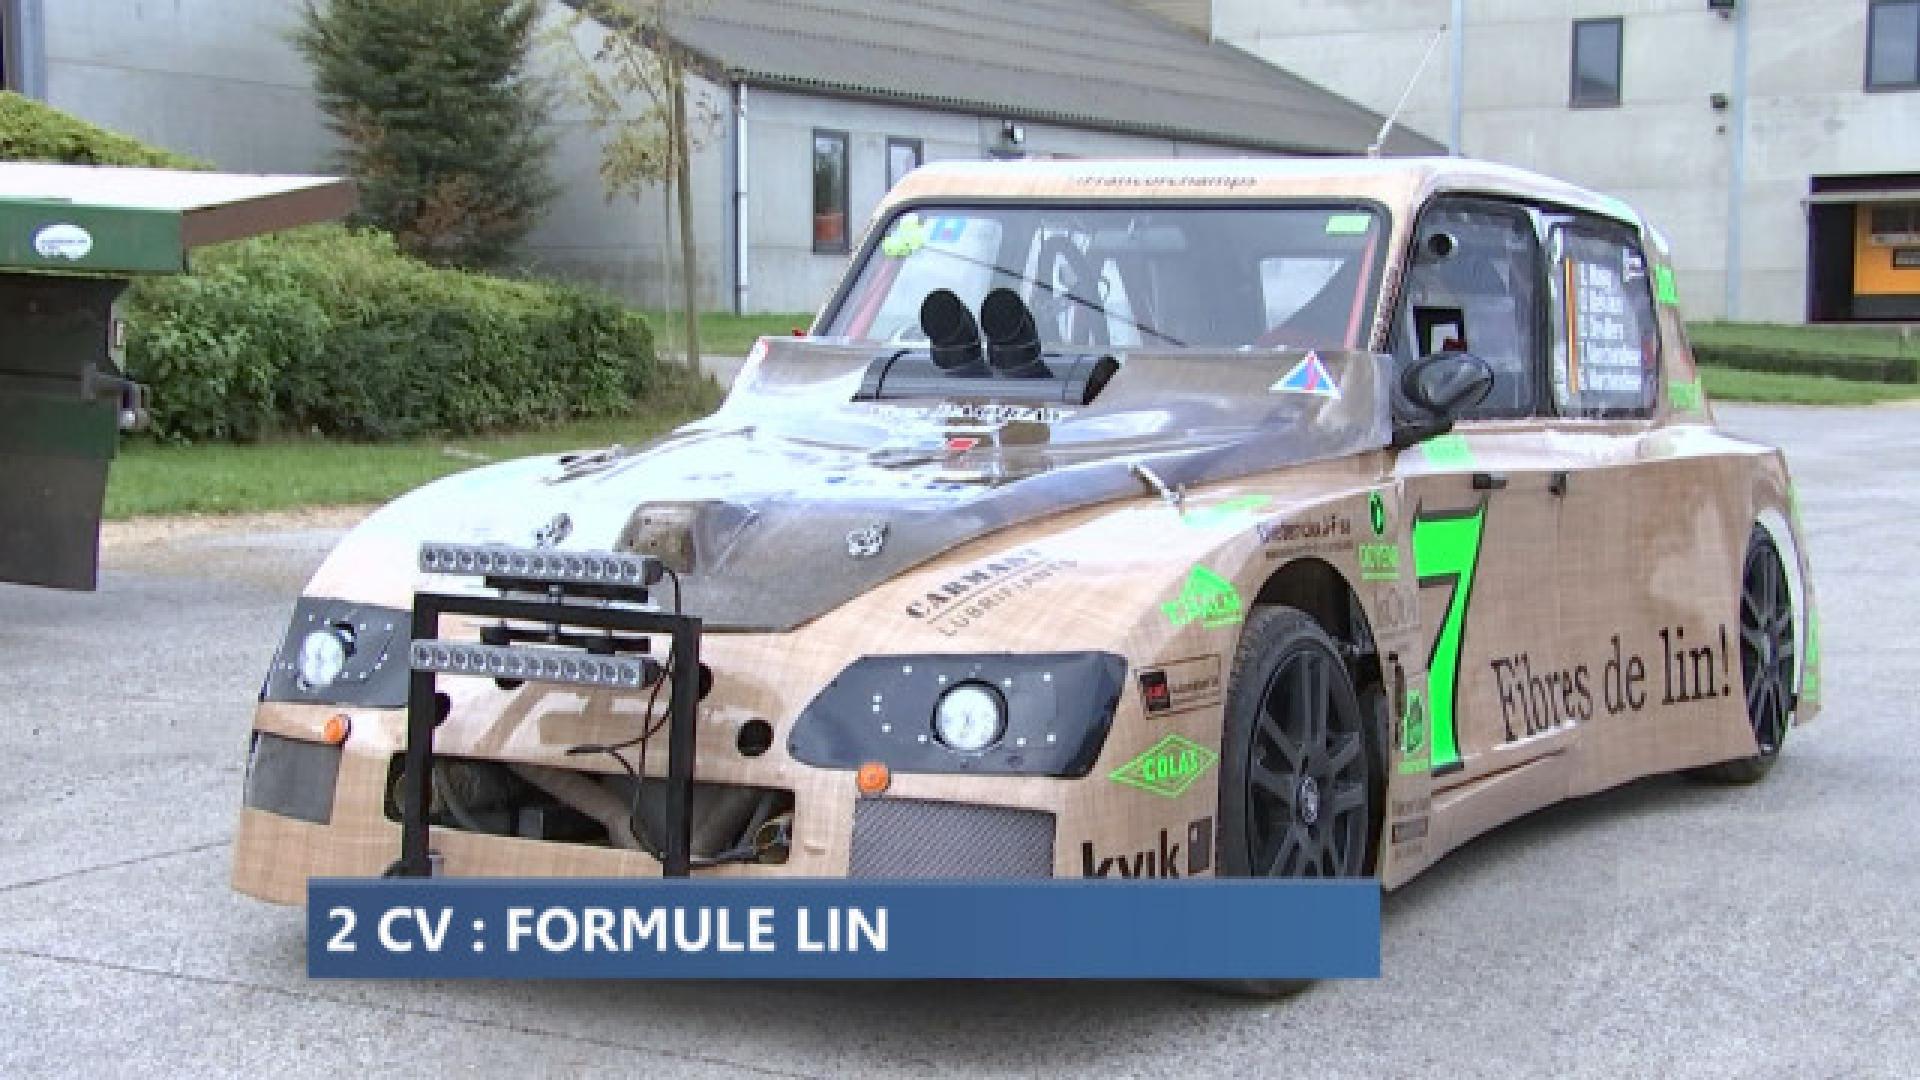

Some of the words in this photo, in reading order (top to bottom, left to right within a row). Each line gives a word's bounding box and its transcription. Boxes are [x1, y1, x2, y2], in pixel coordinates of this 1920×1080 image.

[1411, 503, 1487, 777] 7
[1490, 651, 1593, 742] Fibres
[1604, 634, 1648, 715] de
[1659, 623, 1731, 706] lin!
[1143, 745, 1198, 782] COLAS
